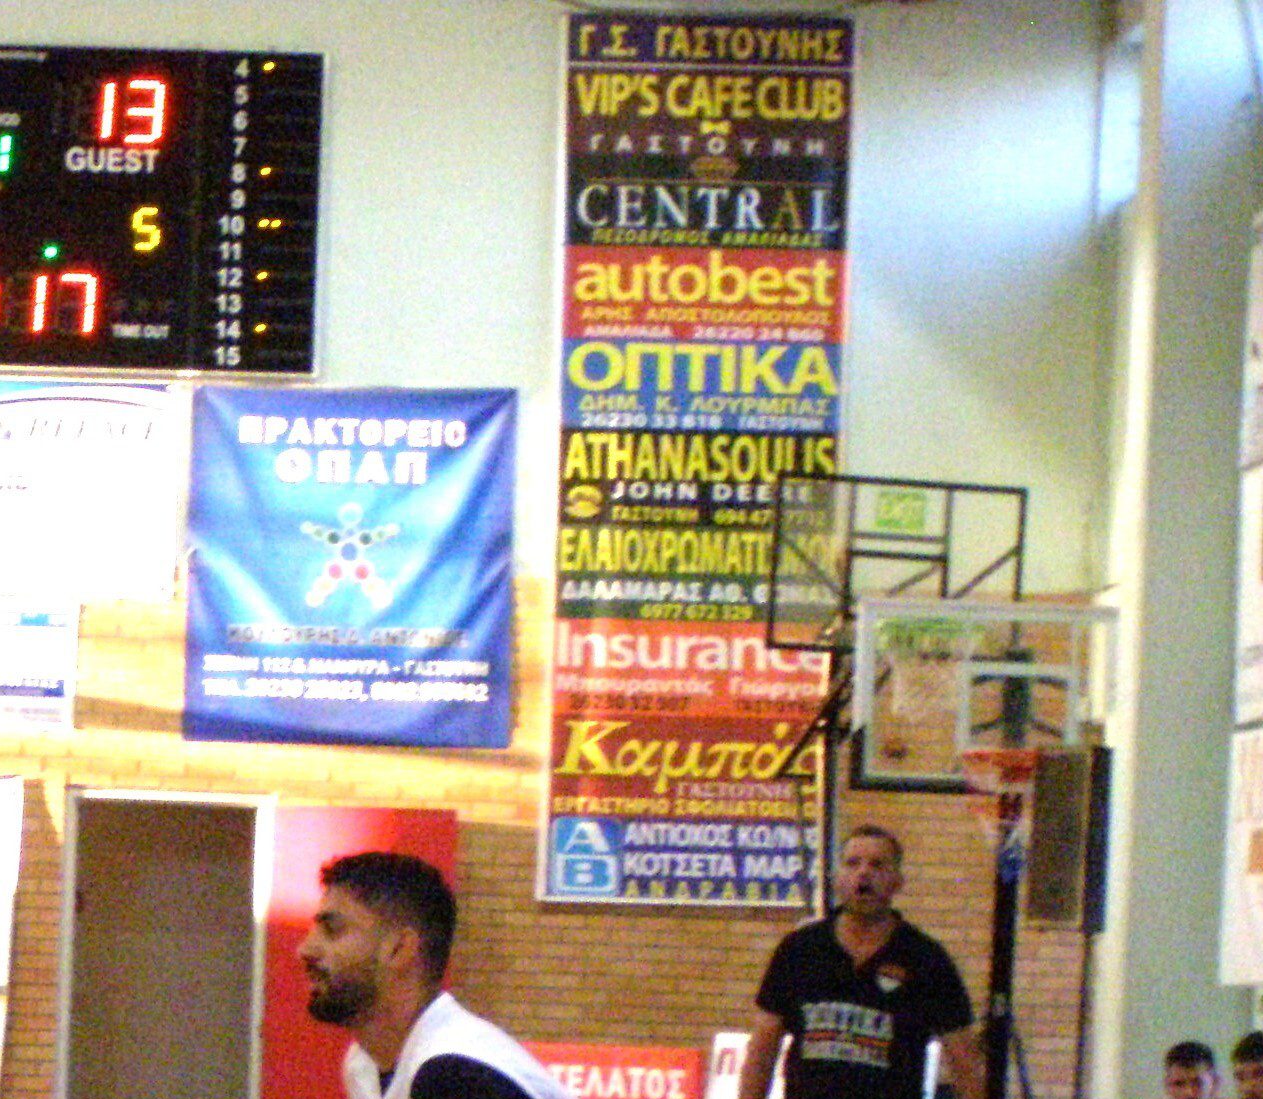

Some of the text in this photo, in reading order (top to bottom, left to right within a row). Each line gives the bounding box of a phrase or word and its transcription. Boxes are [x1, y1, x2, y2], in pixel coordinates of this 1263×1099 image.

[656, 25, 844, 61] ΓΑΣΤΟΥΝΗΣ
[235, 58, 250, 78] 4
[235, 84, 249, 105] 5
[665, 74, 753, 118] CAFE
[756, 76, 845, 121] CLUB
[99, 79, 166, 144] 13
[233, 110, 249, 131] 6
[233, 136, 248, 157] 7
[65, 146, 160, 174] GUEST
[231, 163, 246, 183] 8
[230, 189, 246, 209] 9
[577, 183, 840, 231] CENTRAL
[132, 206, 161, 251] 5
[218, 215, 245, 236] 10
[219, 241, 242, 262] 11
[217, 267, 243, 288] 12
[575, 250, 834, 306] autobest
[216, 293, 242, 314] 13
[216, 320, 241, 339] 14
[214, 346, 241, 366] 15
[567, 341, 837, 396] ΟΠΤΙΚΑ
[238, 414, 467, 448] ΠΡΑΚΤΟΡΕΙΟ
[274, 447, 428, 485] ΟΠΑΠ
[611, 481, 699, 501] JOHN
